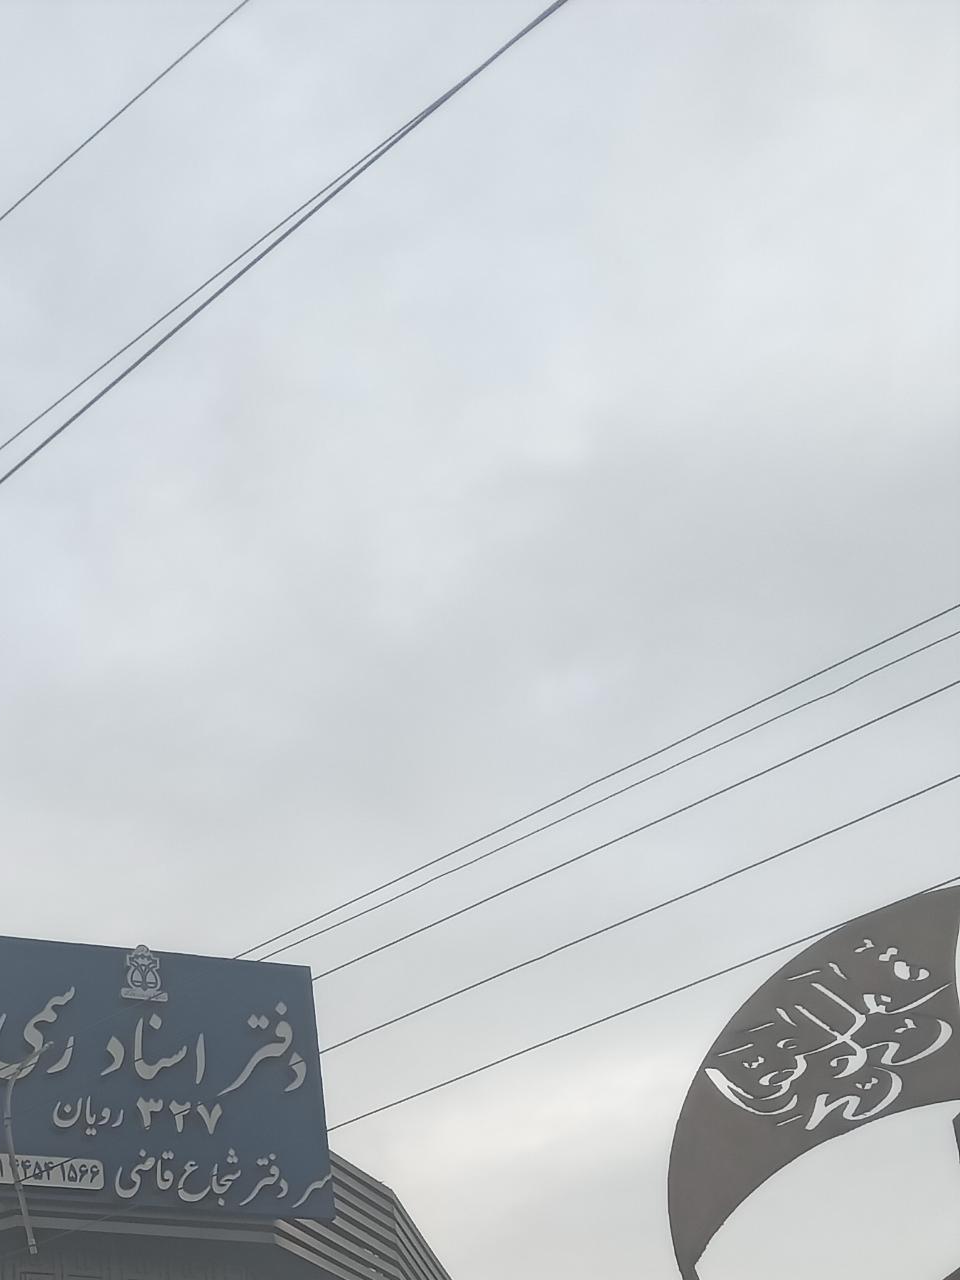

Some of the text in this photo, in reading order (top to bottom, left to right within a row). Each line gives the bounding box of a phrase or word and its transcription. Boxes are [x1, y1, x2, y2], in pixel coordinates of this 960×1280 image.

[100, 1013, 206, 1084] اسناد
[217, 1001, 307, 1097] دفتر
[52, 1096, 223, 1136] ۳۲۷ رویان
[115, 1149, 174, 1198] قاضی
[177, 1147, 241, 1206] شجاع
